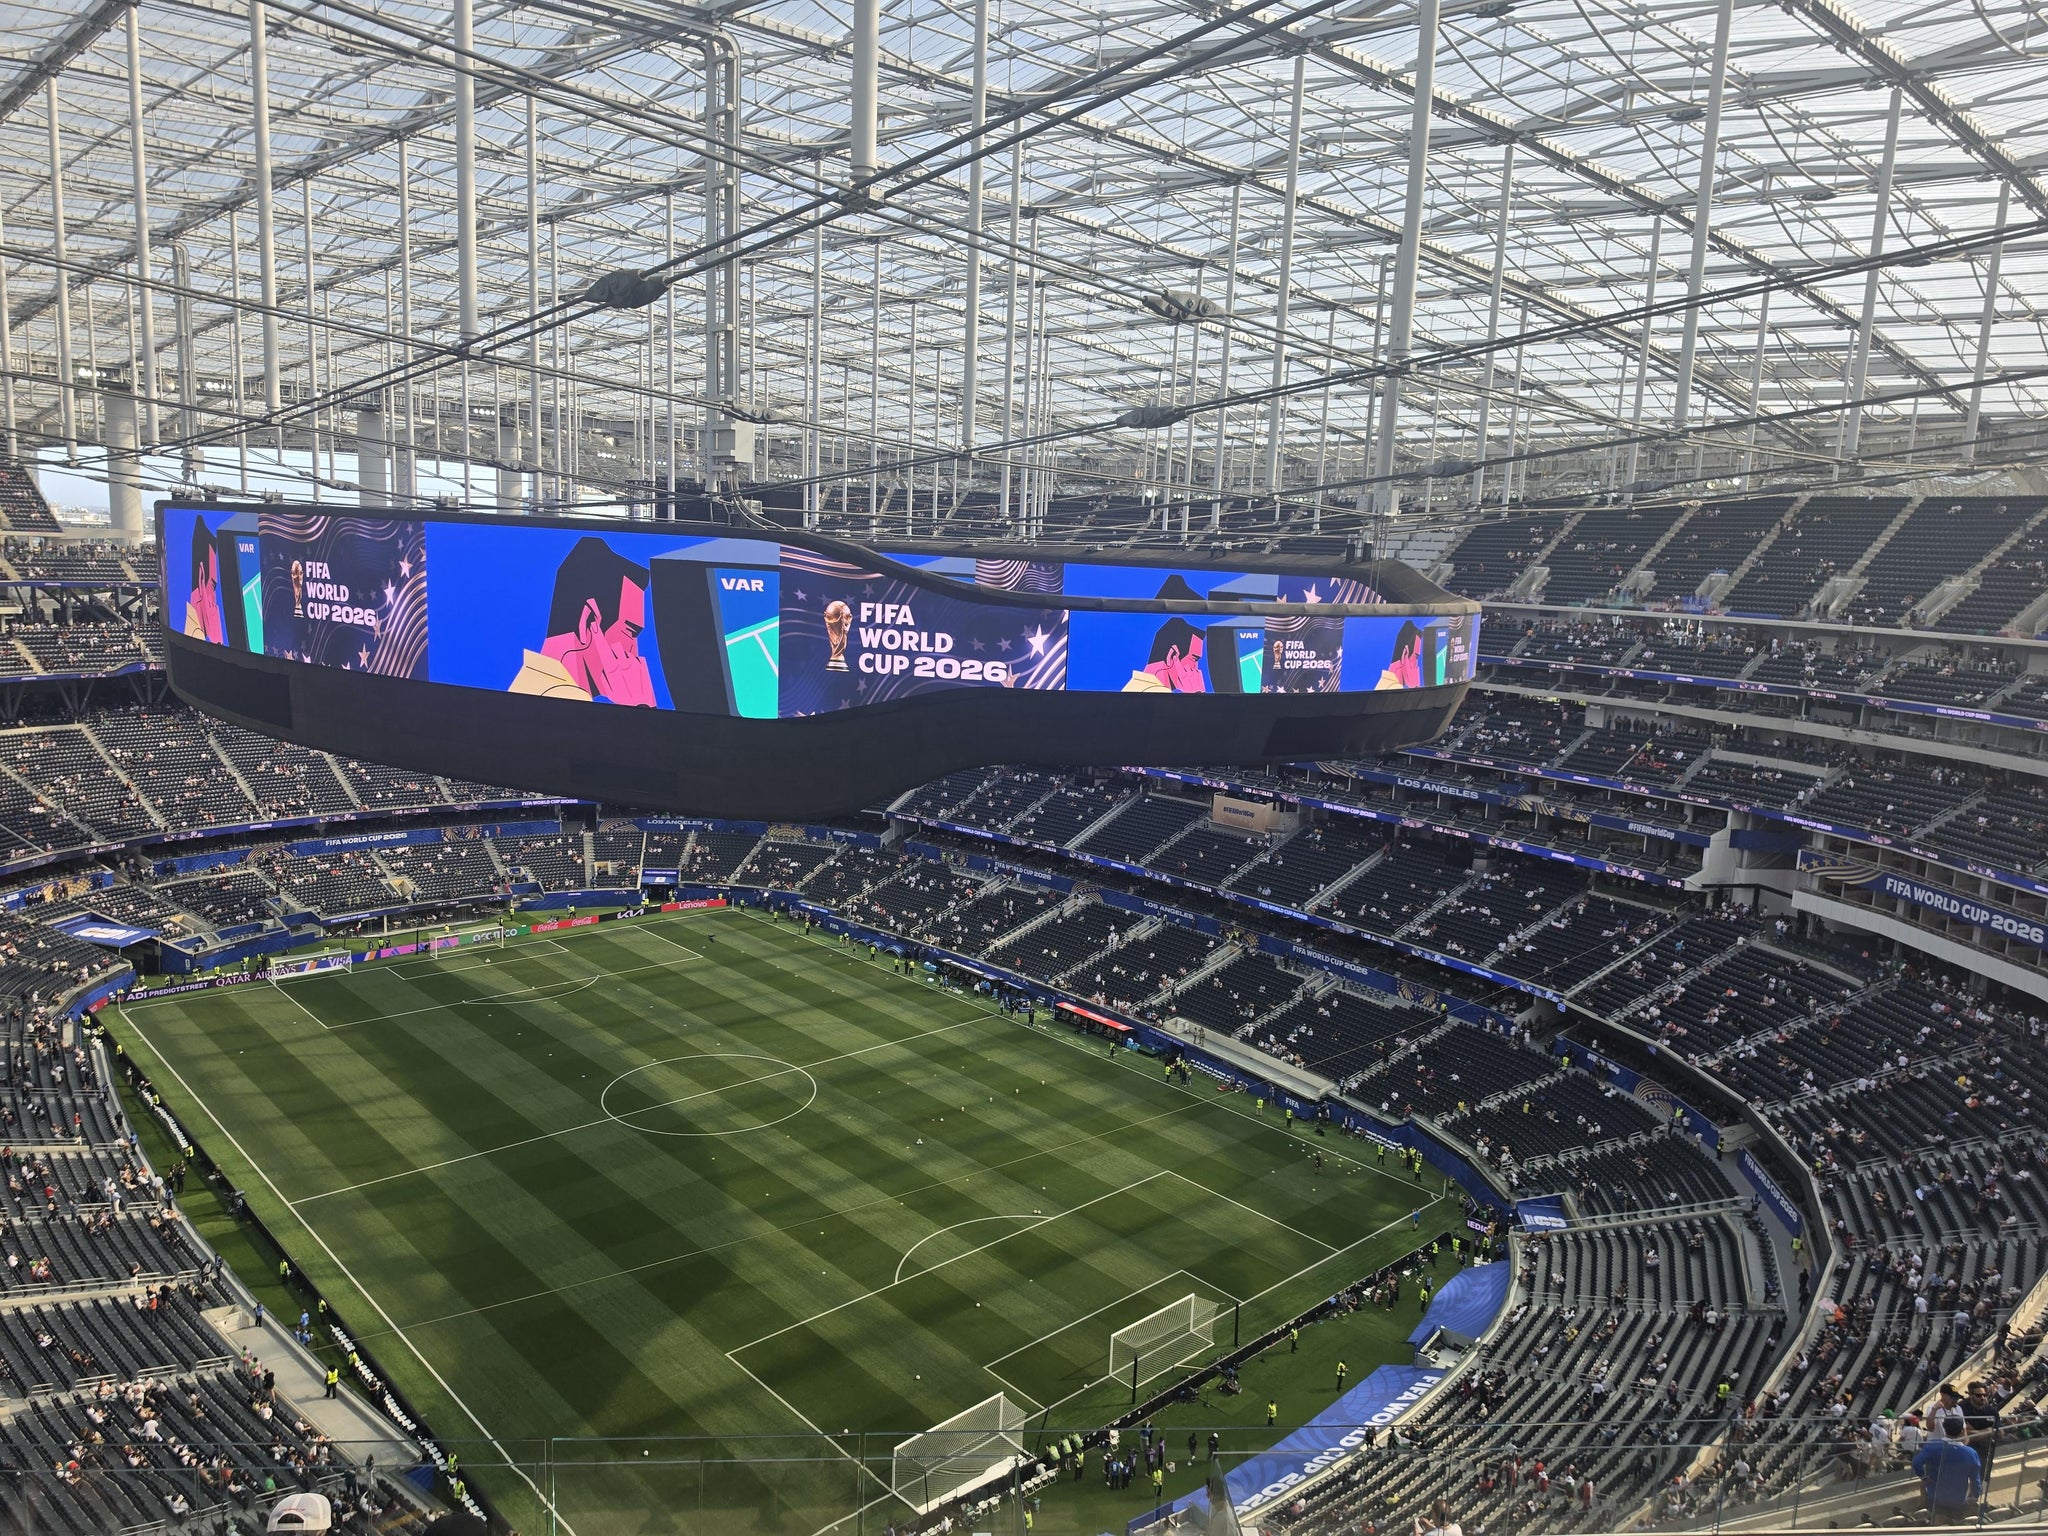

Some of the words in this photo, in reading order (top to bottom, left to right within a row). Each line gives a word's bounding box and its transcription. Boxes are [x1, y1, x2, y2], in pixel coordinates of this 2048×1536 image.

[239, 544, 254, 554] VAR
[306, 561, 330, 580] FIFA
[306, 582, 349, 602] WORLD
[721, 578, 764, 592] VAR
[307, 602, 330, 620] CUP
[332, 606, 376, 627] 2026
[860, 602, 915, 626] FIFA
[859, 627, 954, 653] WORLD
[1285, 640, 1304, 650] FIFA
[1285, 650, 1316, 659] WORLD
[858, 653, 909, 675] CUP
[914, 657, 1007, 682] 2026
[1284, 660, 1302, 669] CUP
[1302, 660, 1330, 669] 2026
[1398, 778, 1420, 789] LOS
[1422, 782, 1479, 799] ANGELES
[342, 836, 367, 845] WORLD
[1628, 822, 1675, 840] #FIFAWorldCup
[679, 900, 707, 909] Lenovo
[1144, 901, 1159, 909] LOS
[1159, 903, 1194, 920] ANGELES
[1886, 877, 1912, 898] FIFA
[1914, 886, 1960, 914] WORLD
[1962, 904, 1990, 924] CUP
[1990, 914, 2044, 944] 2026
[328, 956, 352, 968] VISA
[1293, 945, 1306, 955] FIFA
[1306, 949, 1329, 962] WORLD
[1330, 956, 1344, 967] CUP
[1344, 961, 1368, 975] 2026
[216, 973, 250, 987] QATAR
[254, 966, 296, 980] AIRWAYS
[127, 991, 147, 1001] ADI
[148, 982, 208, 996] PREDICTSTREET
[1285, 1096, 1300, 1110] FIFA
[1744, 1154, 1754, 1171] FIFA
[1754, 1164, 1770, 1190] WORLD
[1395, 1375, 1442, 1400] FIFA
[1303, 1447, 1346, 1474] CUP
